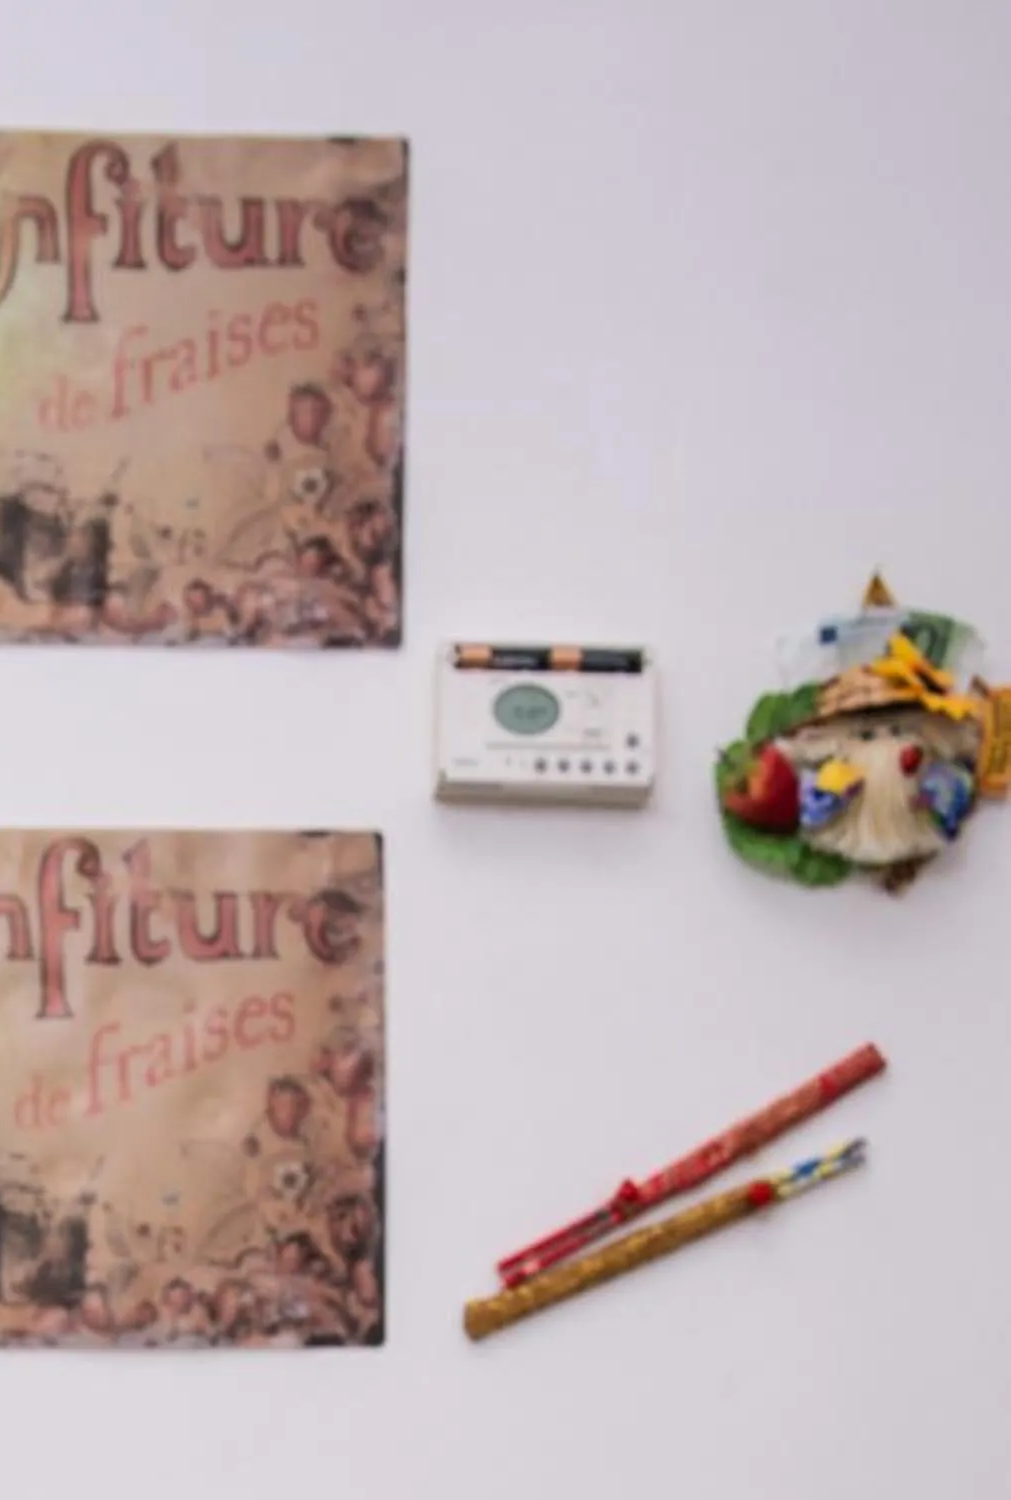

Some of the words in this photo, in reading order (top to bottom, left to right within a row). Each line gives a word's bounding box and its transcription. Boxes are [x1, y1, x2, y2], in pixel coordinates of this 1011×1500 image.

[36, 376, 93, 431] de
[109, 299, 320, 417] fraises
[15, 1079, 69, 1131] de
[89, 990, 296, 1119] fraises
